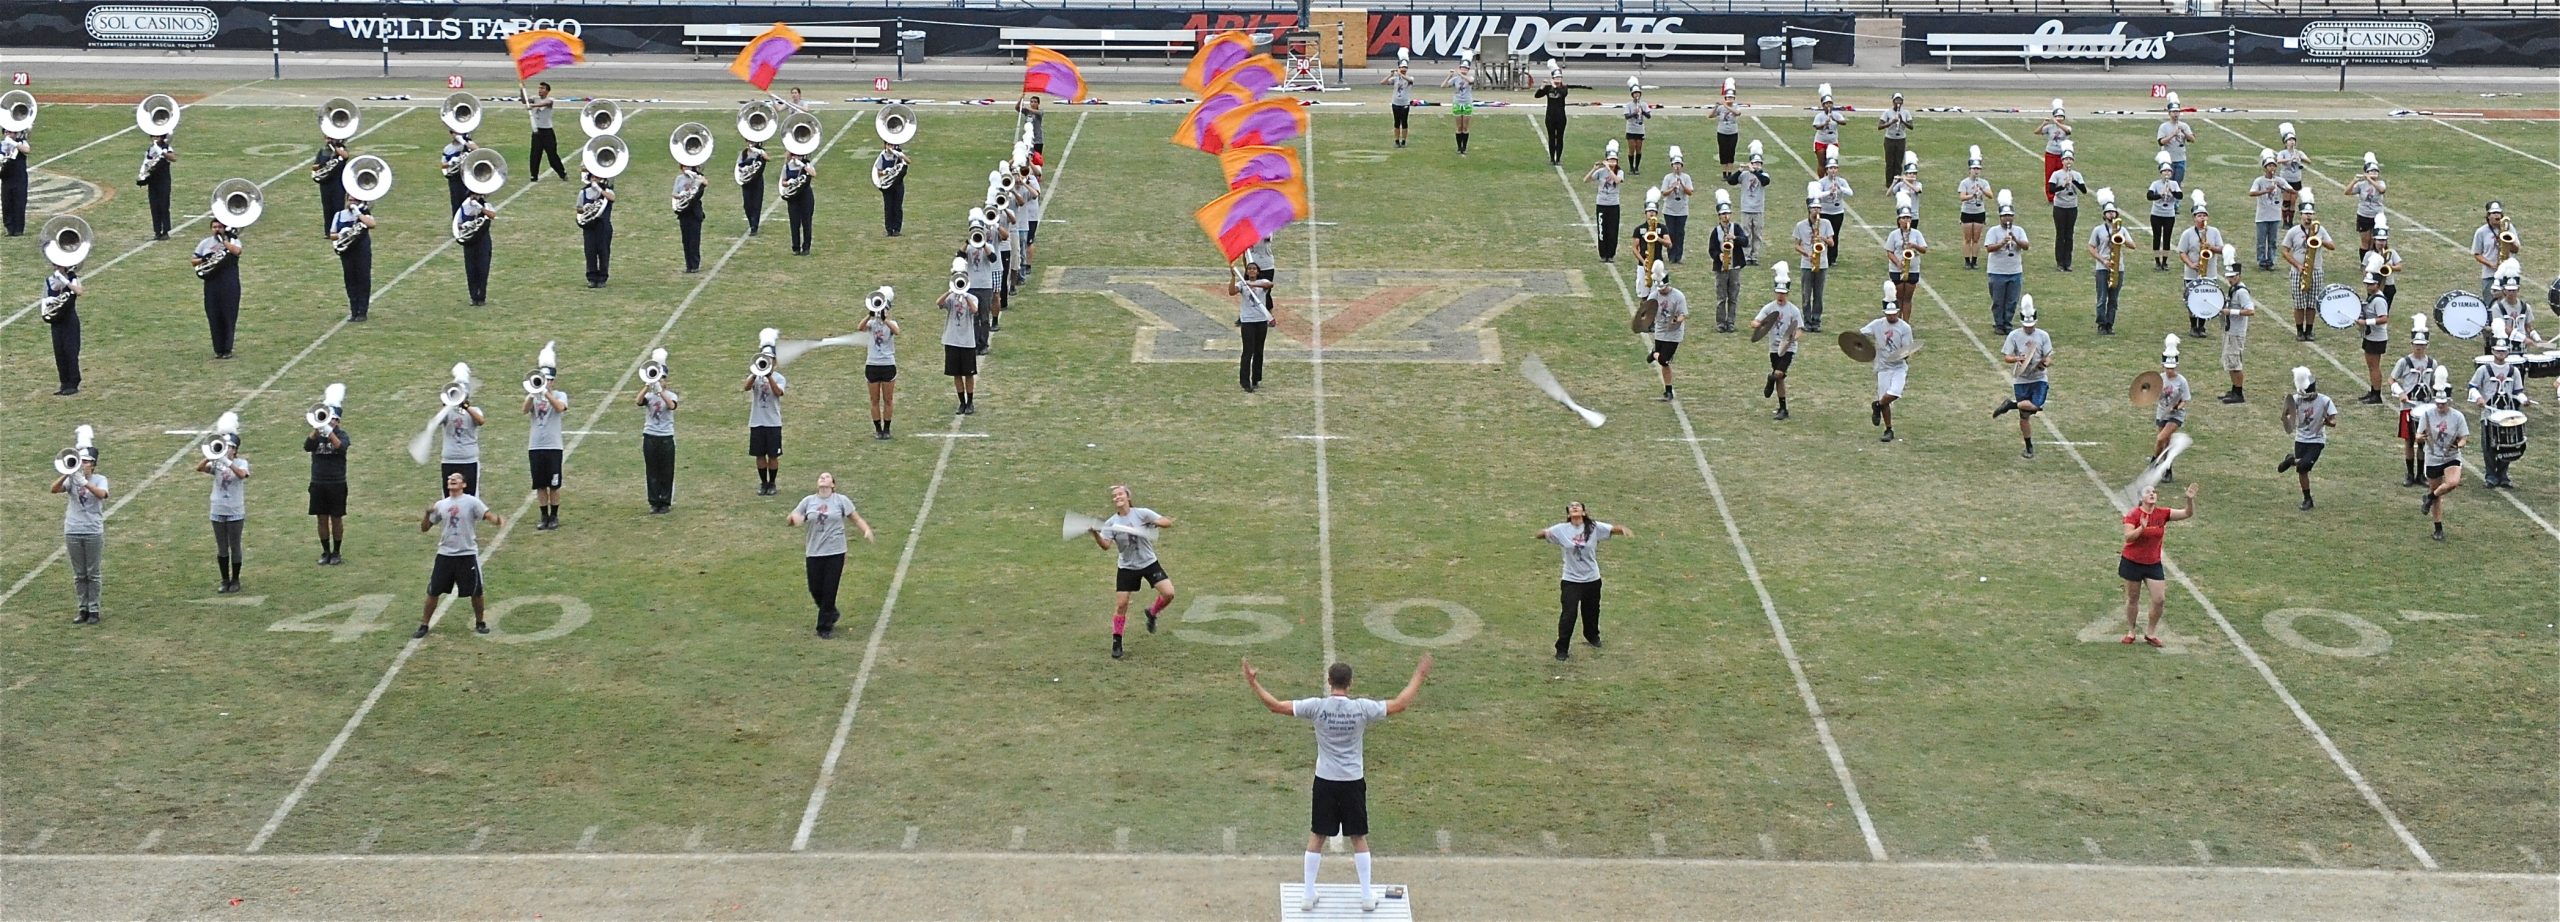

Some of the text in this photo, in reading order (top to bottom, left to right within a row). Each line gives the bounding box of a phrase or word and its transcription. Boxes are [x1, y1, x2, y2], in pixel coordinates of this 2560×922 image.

[100, 16, 204, 30] SOL CASINOS
[346, 17, 460, 39] WELLS
[1411, 14, 1684, 58] WILDCATS
[2314, 32, 2421, 46] SOL CASINOS
[1297, 59, 1309, 69] 50
[14, 73, 27, 84] 20
[449, 76, 462, 87] 30
[875, 78, 888, 90] 40
[2153, 85, 2166, 97] 30
[1172, 594, 1486, 648] 50
